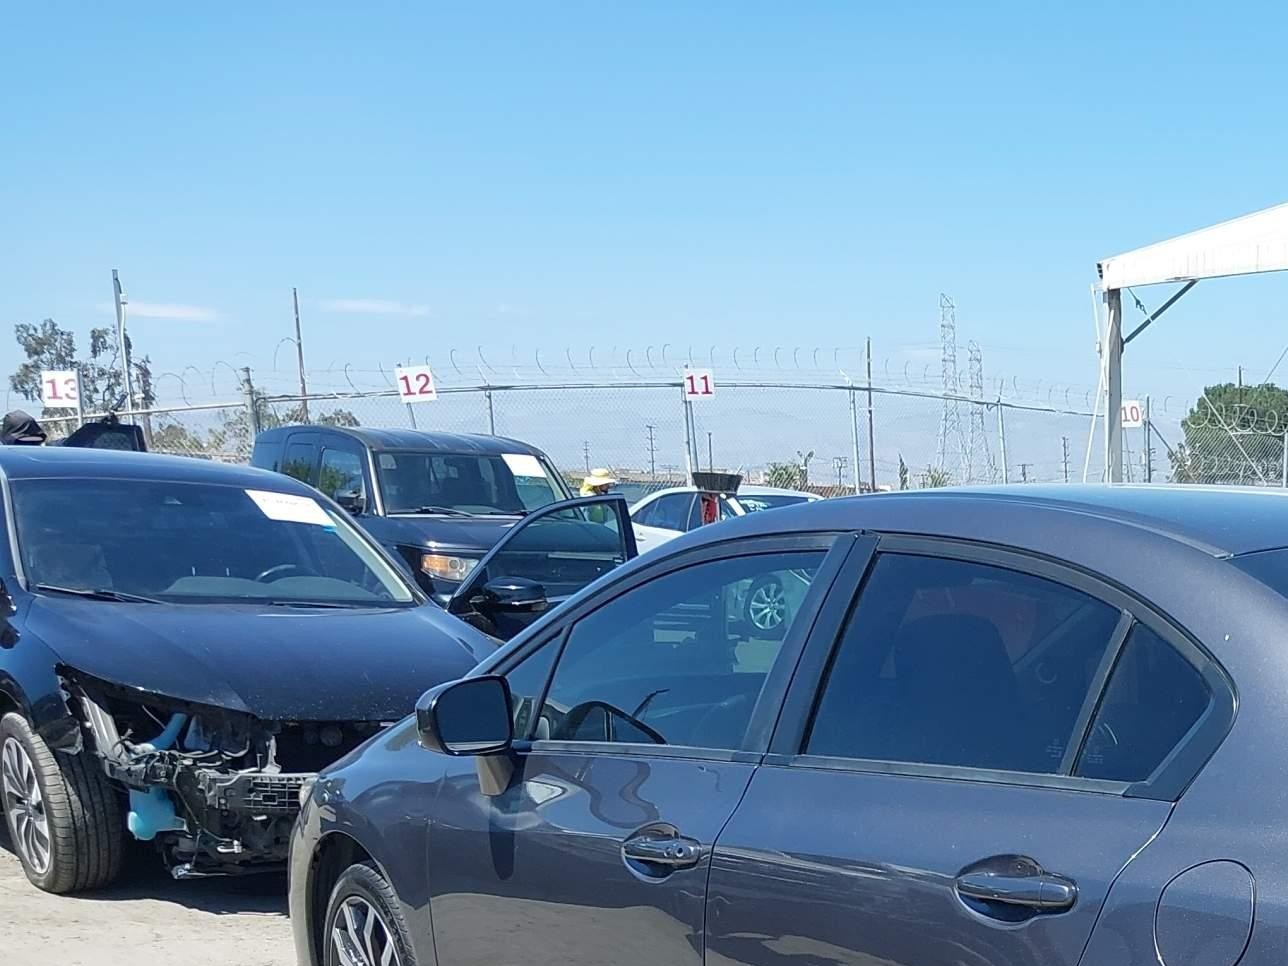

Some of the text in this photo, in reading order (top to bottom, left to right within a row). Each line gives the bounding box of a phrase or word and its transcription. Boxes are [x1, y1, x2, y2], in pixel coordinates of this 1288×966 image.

[45, 378, 78, 400] 13
[399, 373, 433, 397] 12
[686, 375, 714, 395] 11
[1121, 406, 1140, 422] 10
